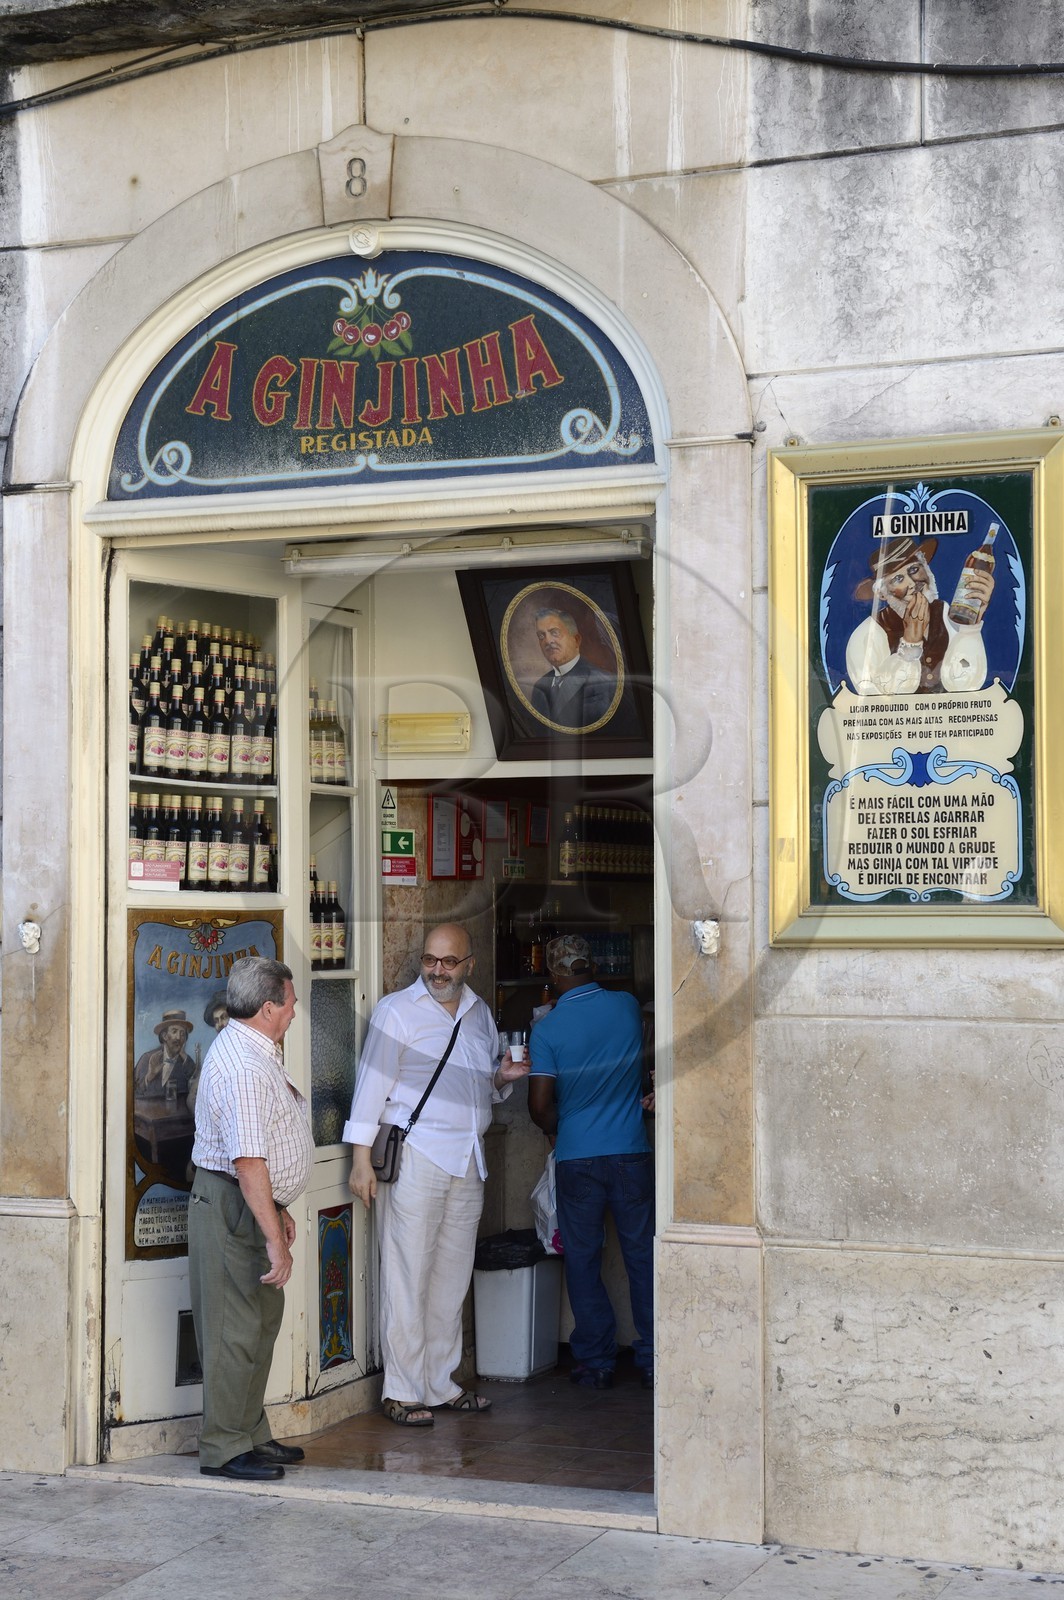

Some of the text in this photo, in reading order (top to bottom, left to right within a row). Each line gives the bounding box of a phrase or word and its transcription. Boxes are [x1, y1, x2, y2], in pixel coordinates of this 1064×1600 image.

[345, 157, 367, 198] 8
[186, 314, 564, 430] A GINJINHA
[300, 426, 432, 454] REGISTADA
[874, 512, 966, 536] A GINJINHA
[850, 705, 869, 713] LICOR
[871, 704, 908, 712] PRODUZIDO
[938, 700, 968, 710] PRÓPRIO
[949, 714, 998, 723] RECOMPENSAS
[862, 729, 902, 740] EXPOSIÇÕES
[949, 728, 994, 737] PARTICIPADO
[850, 792, 994, 809] É MAIS FÁCIL COM UMA MÃO
[858, 811, 984, 824] DEZ ESTRELAS AGARRAR
[868, 827, 977, 839] FAZER O SOL ESFRIAR
[848, 842, 995, 854] REDUZIR O MUNDO A GRUDE
[848, 857, 998, 872] MAS GINJA COM TAL VIRTUDE
[859, 871, 987, 884] É DIFICIL DE ENCONTRAR
[147, 944, 163, 969] A
[157, 1236, 169, 1244] COPO
